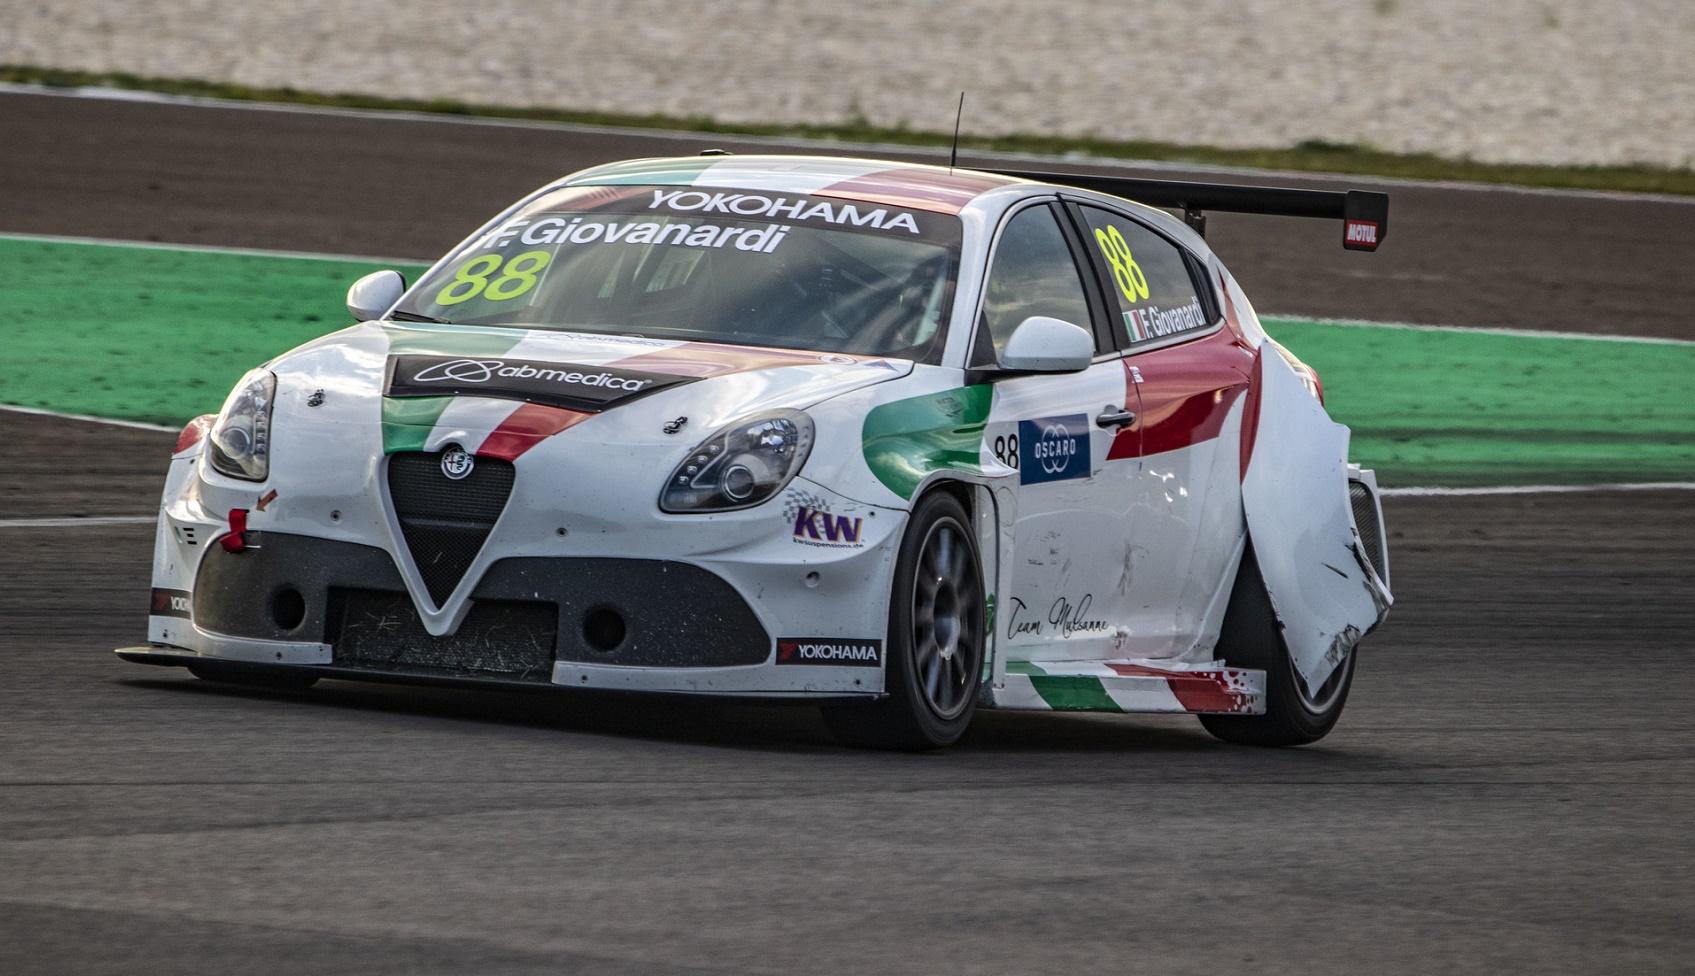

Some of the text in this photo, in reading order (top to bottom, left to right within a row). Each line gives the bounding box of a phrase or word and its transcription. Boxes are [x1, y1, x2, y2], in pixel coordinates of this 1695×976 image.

[649, 190, 920, 234] YOKOHAMA
[483, 217, 791, 253] F. Giovanardi
[1347, 224, 1376, 243] MOTUL
[435, 251, 551, 305] 88
[1095, 225, 1149, 303] 88
[1149, 296, 1207, 337] Giovanardi
[995, 433, 1018, 469] 88
[1035, 439, 1076, 459] OSCARO
[793, 506, 863, 543] KW
[1008, 594, 1109, 639] Team Mulsanne
[798, 645, 878, 660] YOKOHAMA
